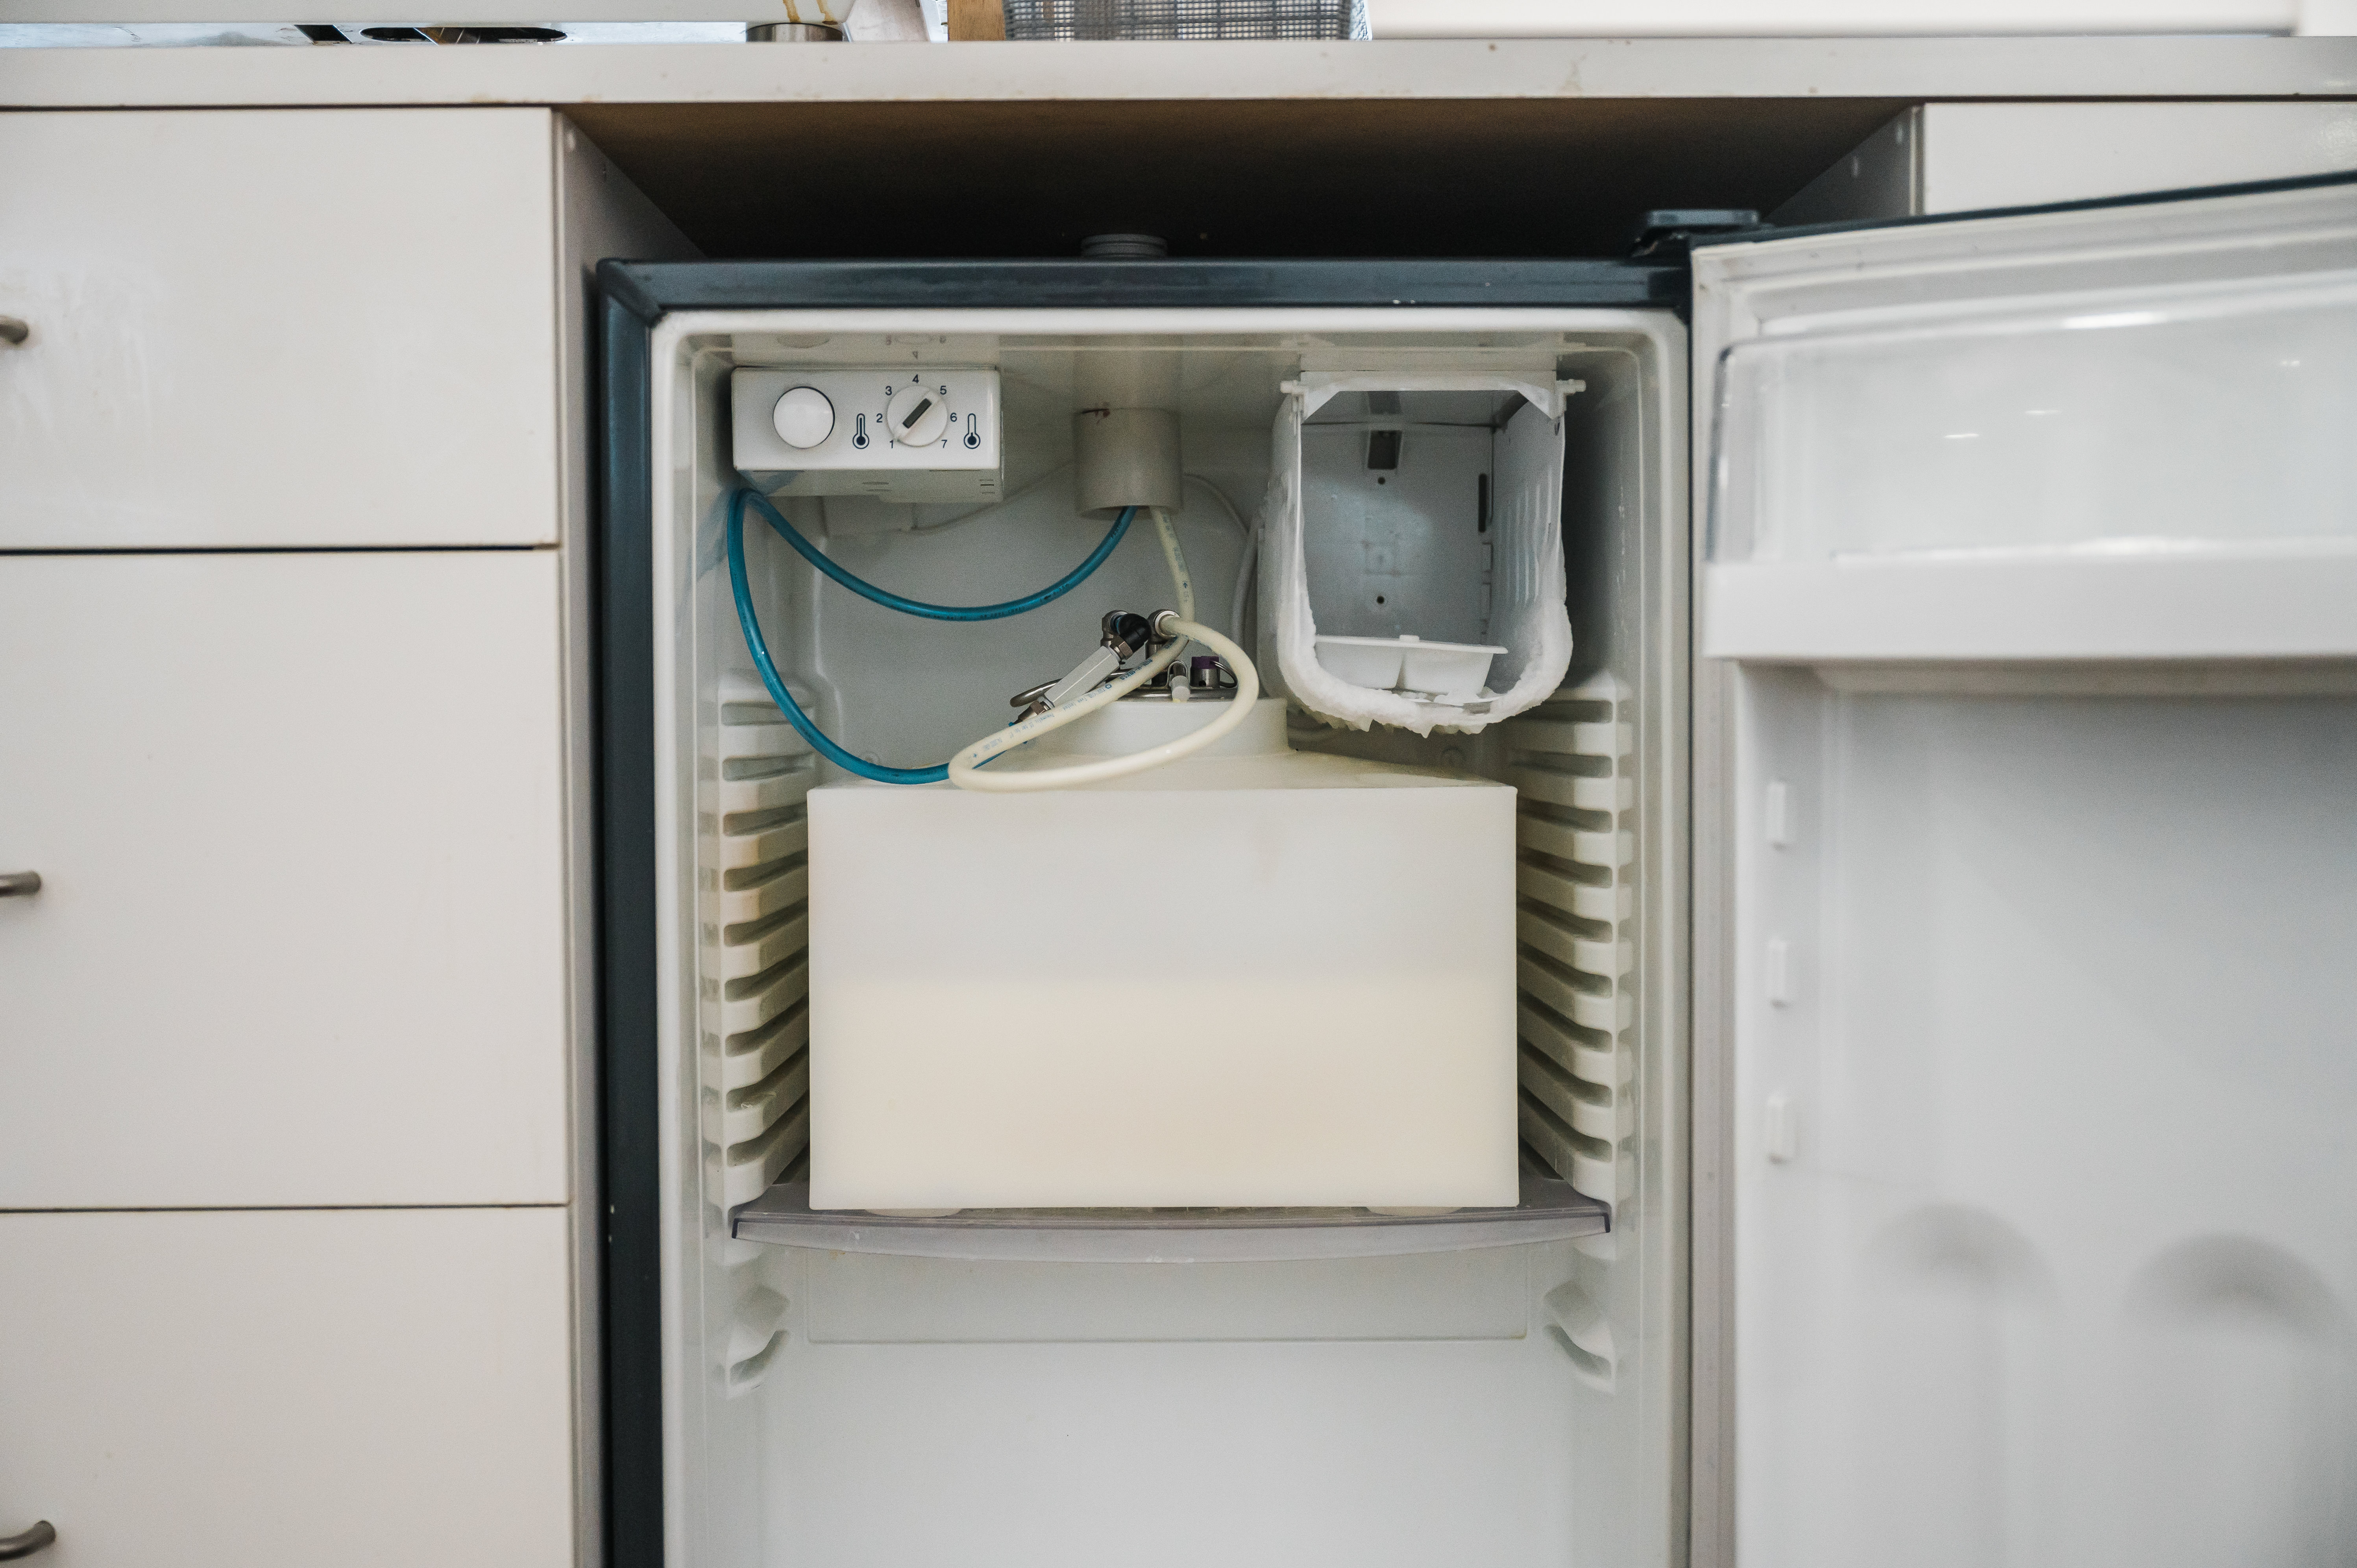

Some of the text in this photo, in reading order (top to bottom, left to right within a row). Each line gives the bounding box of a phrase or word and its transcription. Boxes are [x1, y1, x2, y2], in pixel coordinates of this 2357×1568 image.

[912, 374, 919, 384] 4
[885, 386, 893, 396] 3
[939, 385, 947, 395] 5
[876, 413, 883, 423] 2
[950, 412, 958, 422] 6
[889, 440, 894, 449] 1
[941, 439, 948, 449] 7
